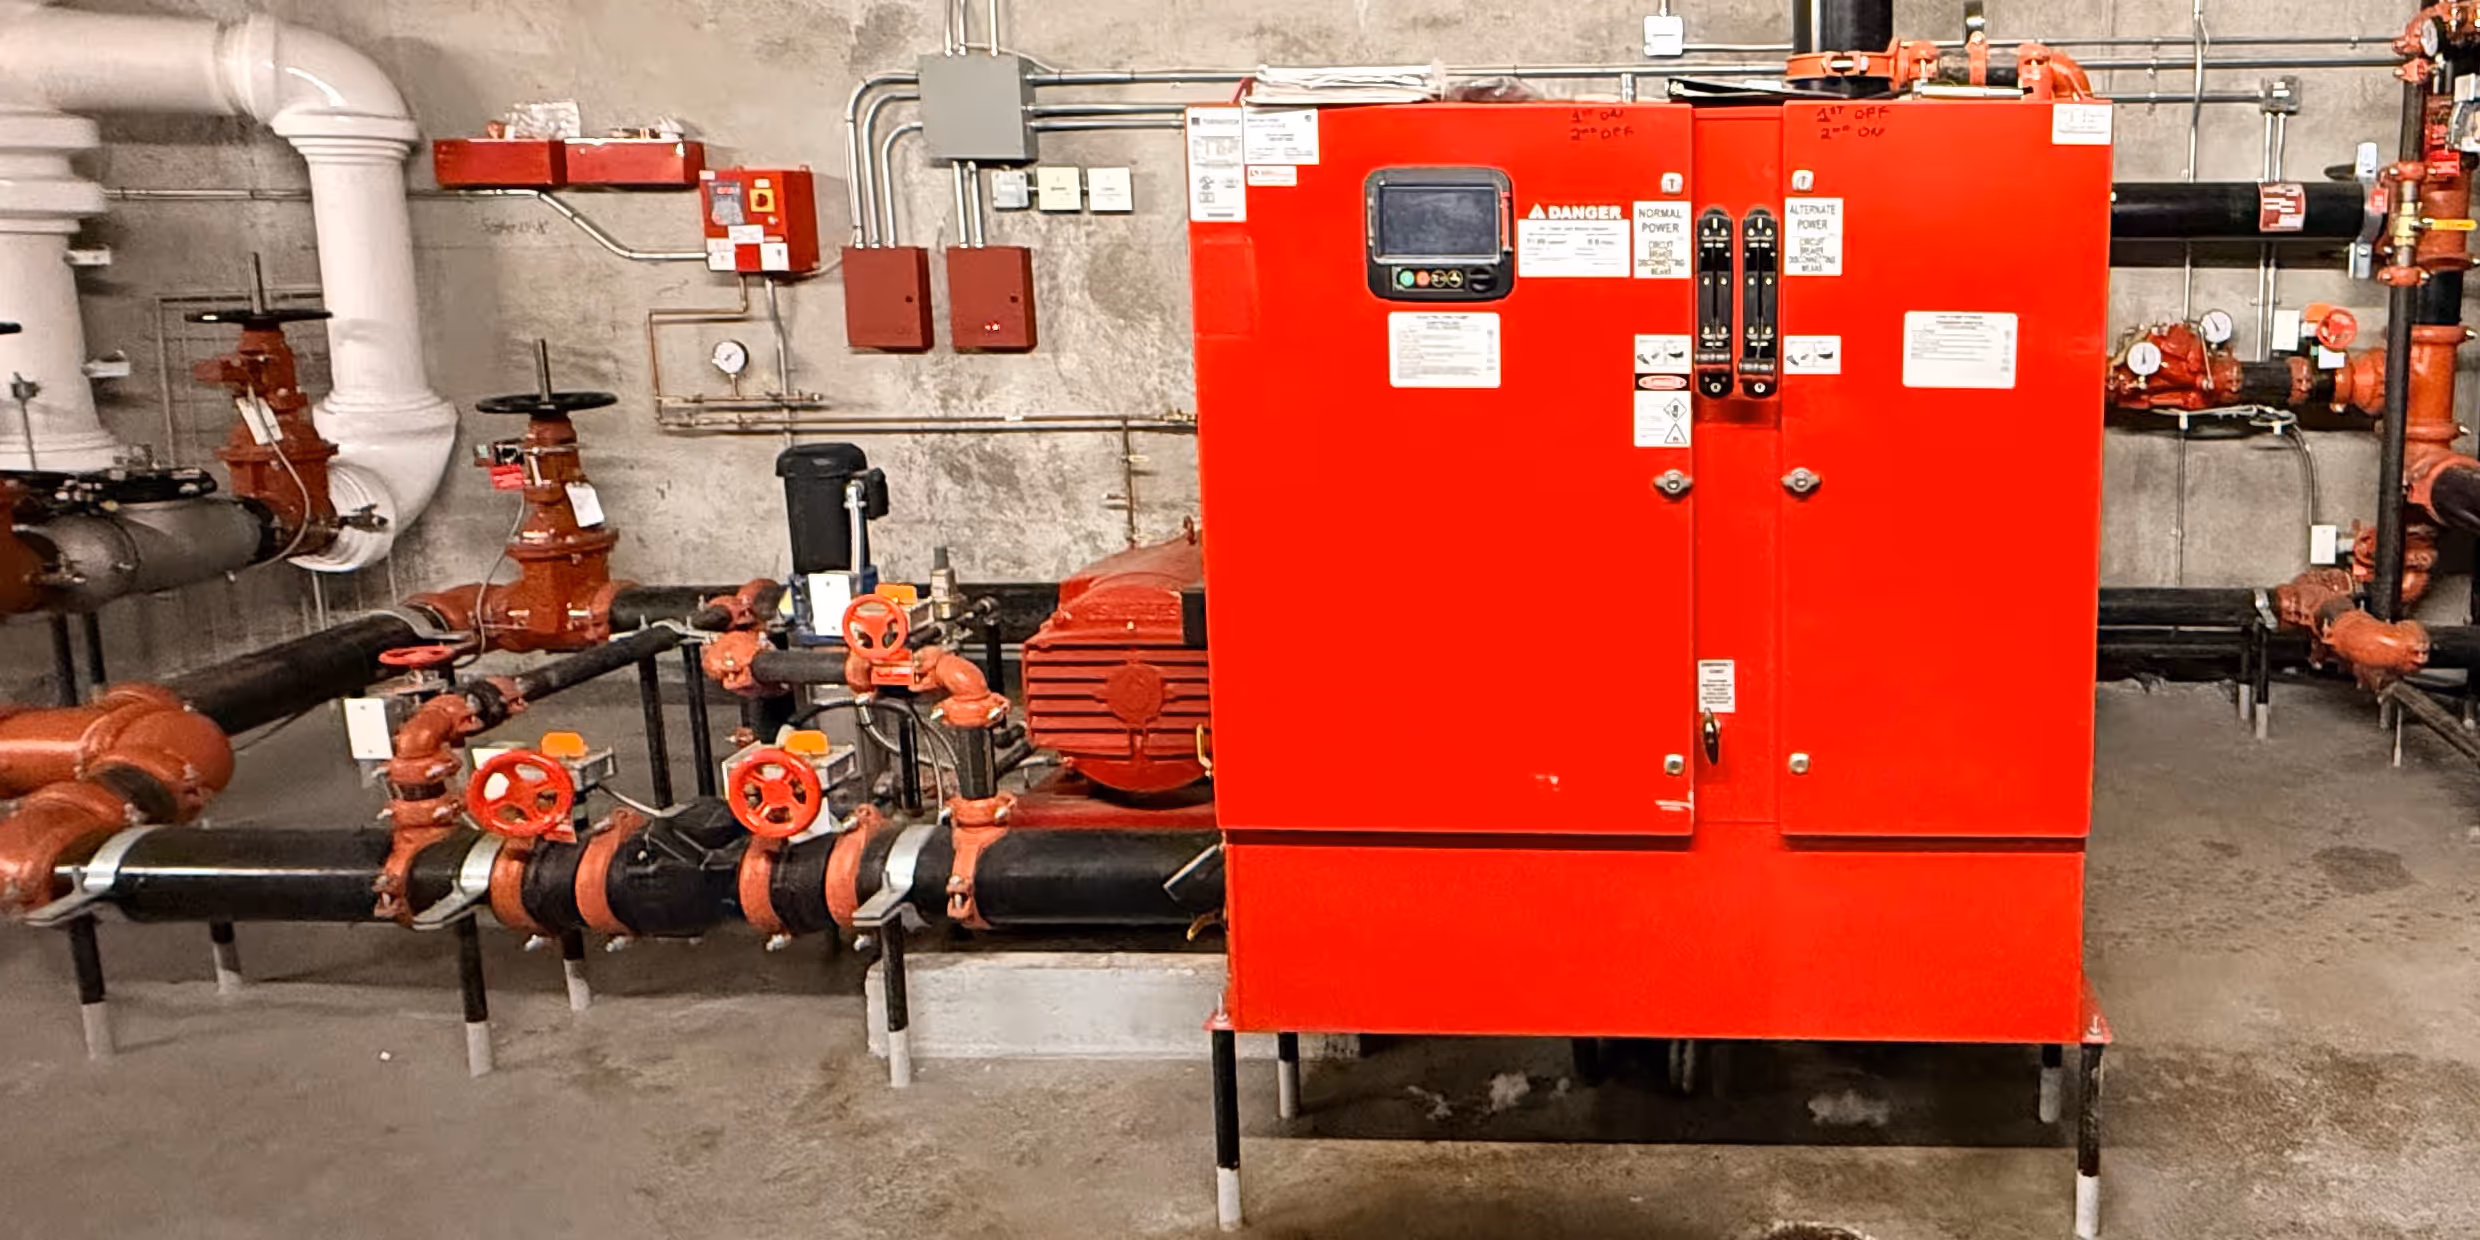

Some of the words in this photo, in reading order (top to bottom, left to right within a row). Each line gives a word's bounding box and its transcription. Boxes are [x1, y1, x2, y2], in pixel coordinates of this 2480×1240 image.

[1858, 126, 1886, 138] ON
[1548, 205, 1622, 220] DANGER
[1638, 208, 1683, 219] NORMAL
[1790, 204, 1836, 216] ALTERNATE
[1641, 222, 1680, 234] POWER
[1797, 219, 1828, 231] POWER
